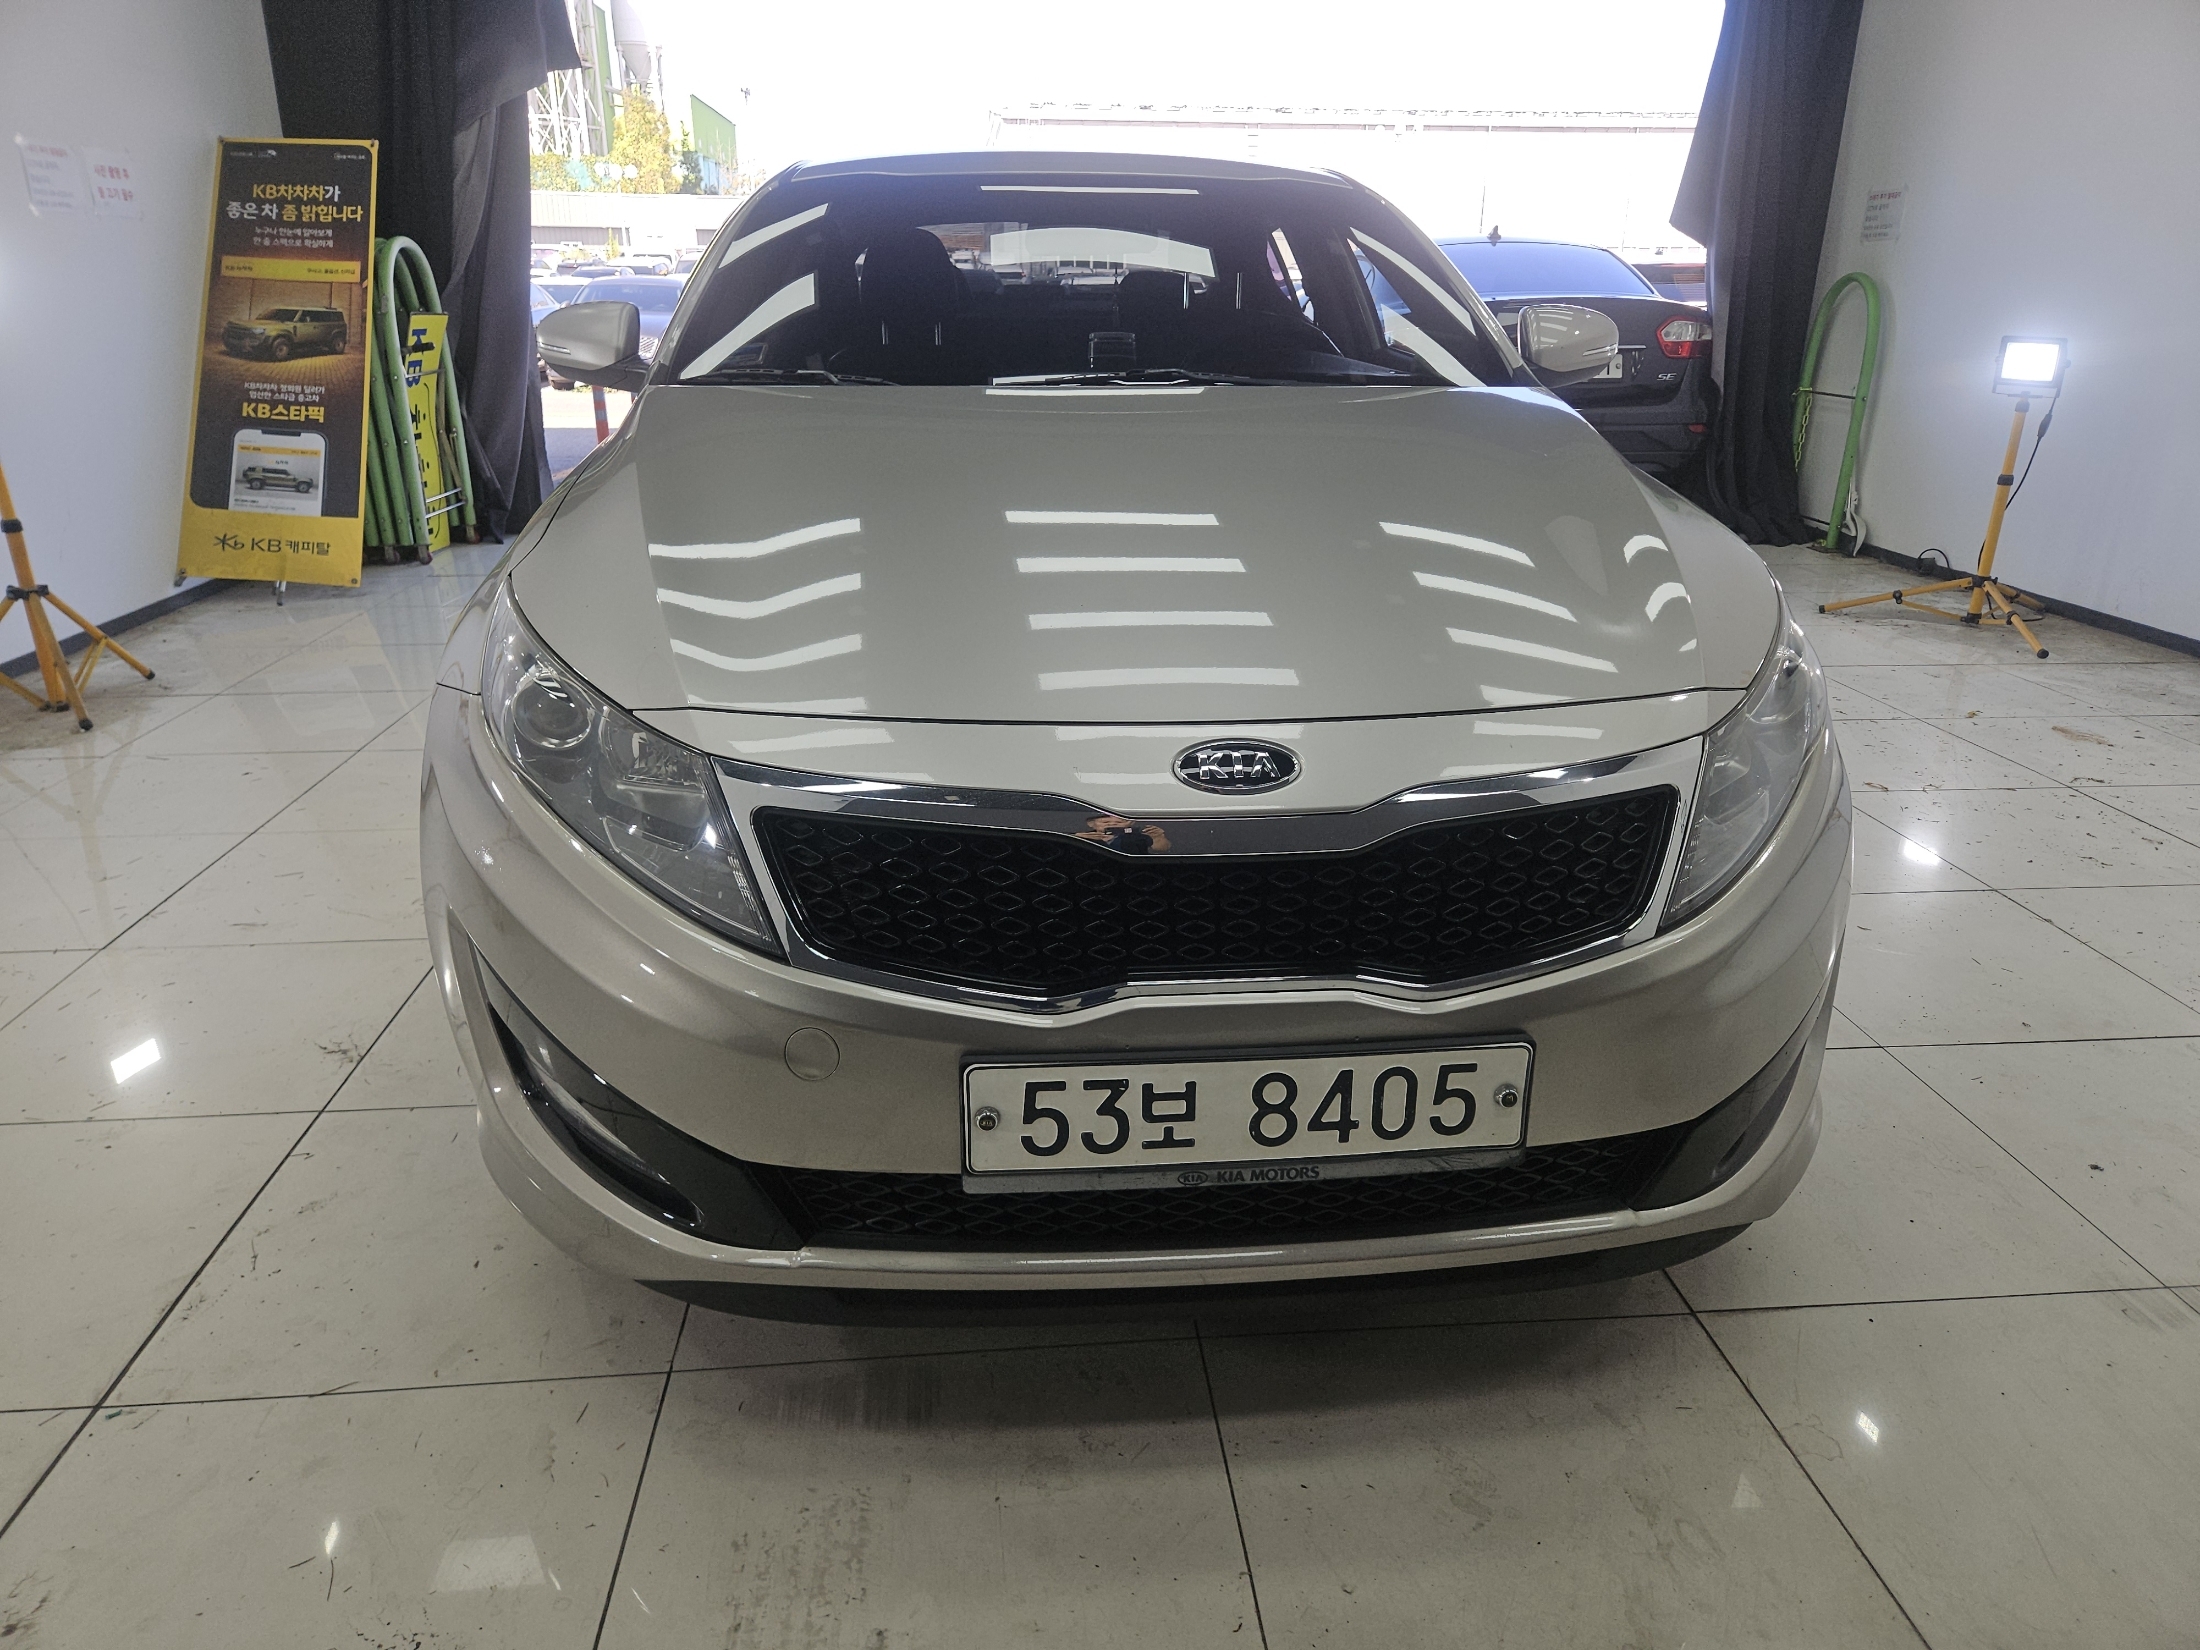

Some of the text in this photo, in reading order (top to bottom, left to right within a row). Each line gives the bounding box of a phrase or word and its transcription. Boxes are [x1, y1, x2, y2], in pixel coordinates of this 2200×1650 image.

[252, 183, 341, 202] KB차차차가
[226, 201, 363, 222] 좋은 차 좀 밝힙니다
[255, 226, 277, 235] 누구나
[279, 227, 301, 237] 한눈에
[1656, 372, 1677, 381] SE
[242, 401, 325, 423] KB스타픽
[251, 537, 282, 553] KB
[285, 540, 331, 556] 캐피탈
[1197, 751, 1281, 780] KIA
[1019, 1061, 1480, 1158] 53보 8405
[1182, 1165, 1320, 1184] KIA KIA MOTORS
